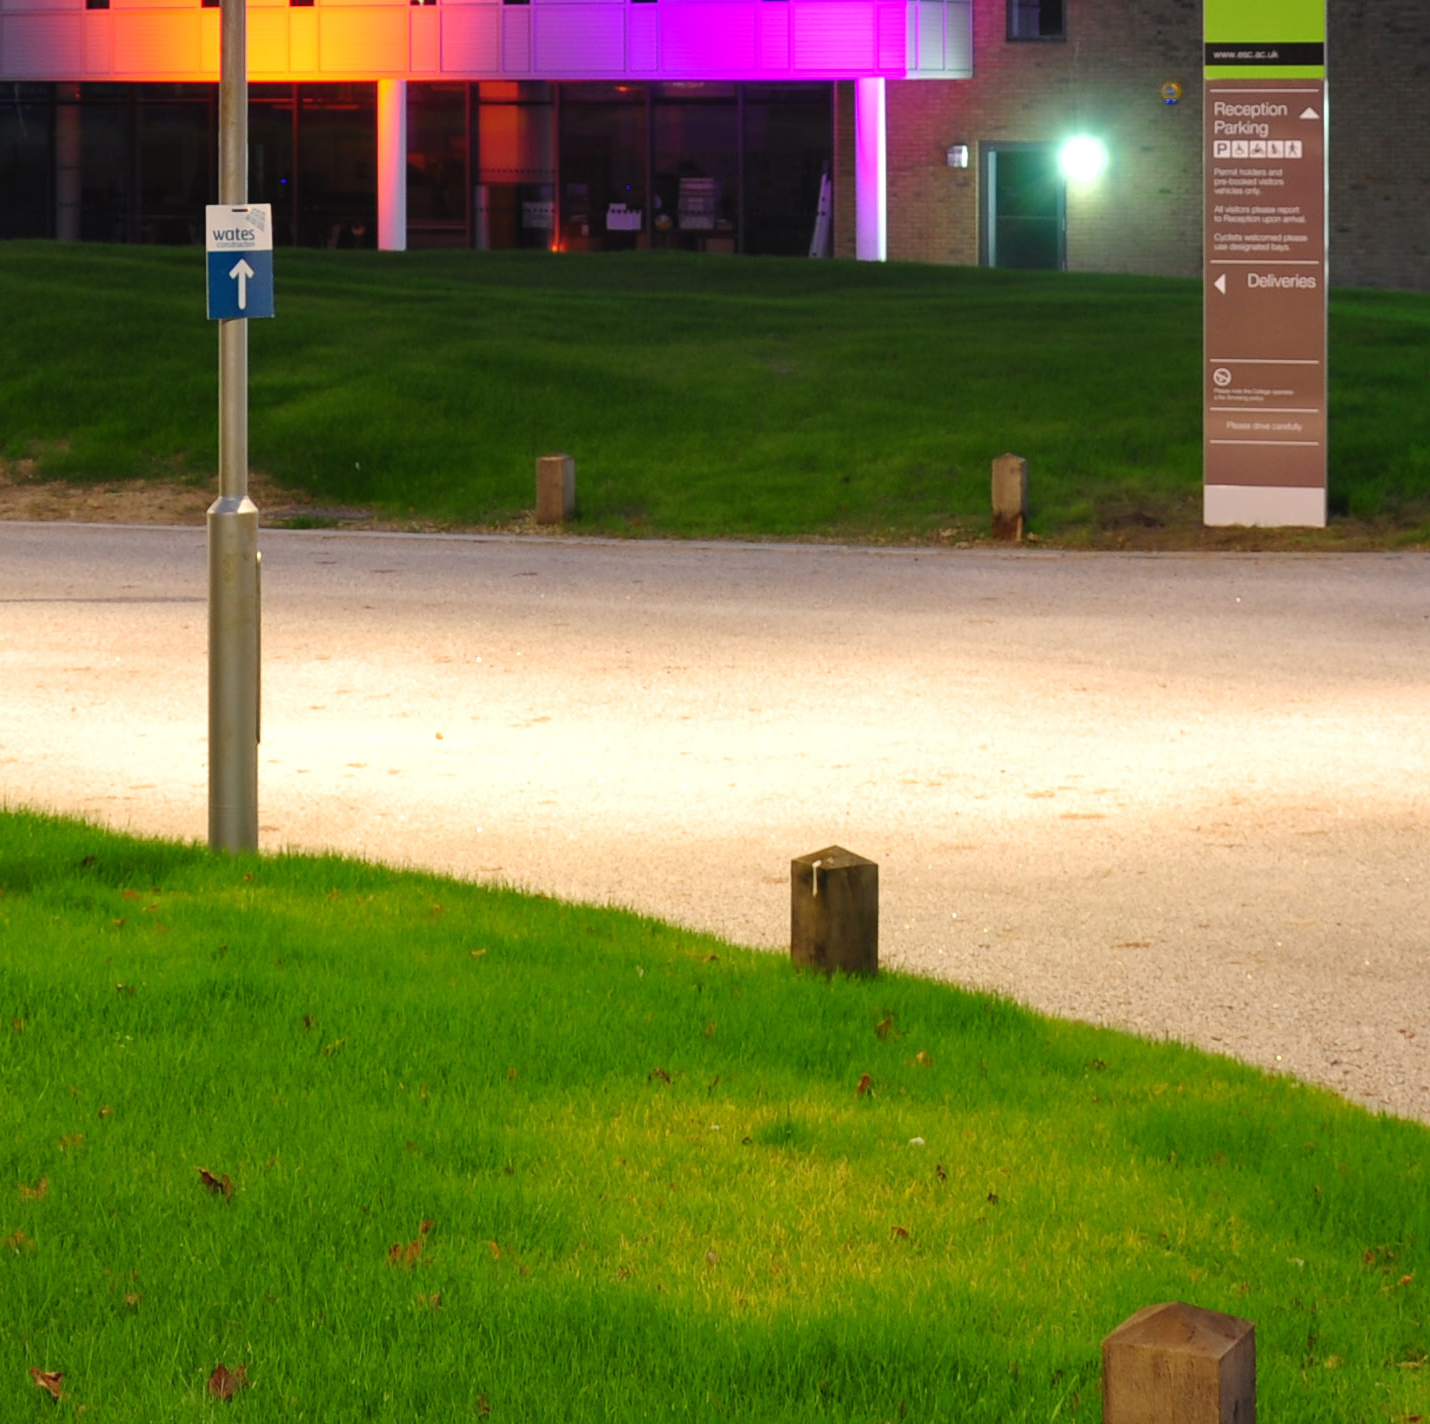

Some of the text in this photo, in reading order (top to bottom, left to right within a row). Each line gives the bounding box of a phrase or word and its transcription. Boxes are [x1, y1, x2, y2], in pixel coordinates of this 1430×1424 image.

[1213, 50, 1279, 59] www.esc.ac.uk
[1214, 102, 1288, 119] Reception
[1214, 120, 1269, 138] Parking
[1217, 143, 1228, 155] P
[212, 227, 255, 241] wates
[1247, 273, 1316, 289] Deliveries
